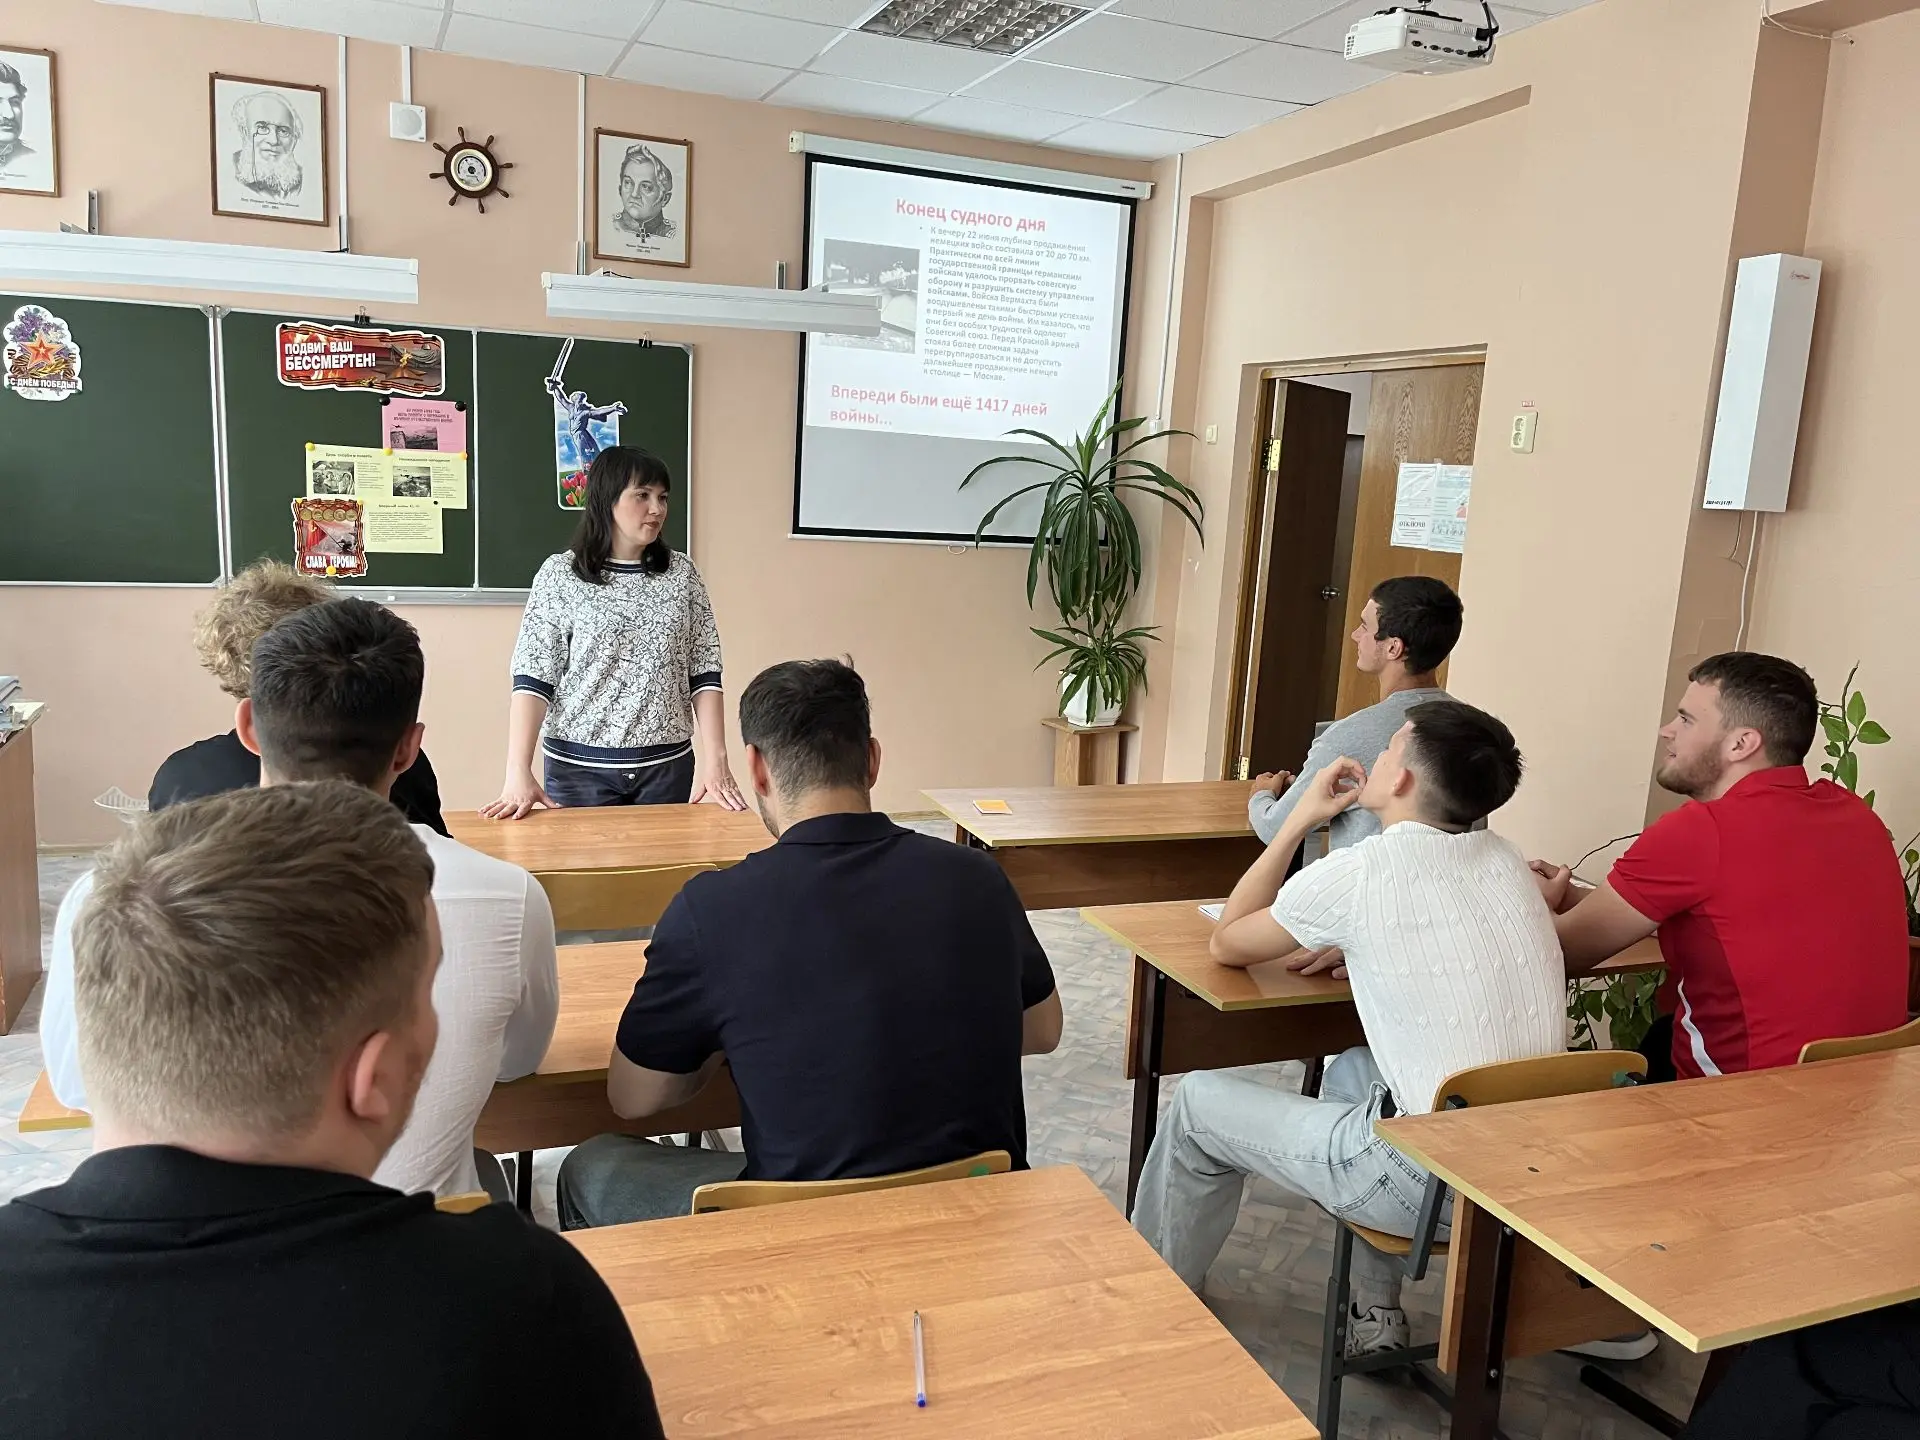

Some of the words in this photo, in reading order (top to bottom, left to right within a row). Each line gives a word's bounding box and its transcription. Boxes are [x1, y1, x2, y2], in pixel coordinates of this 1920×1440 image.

[896, 198, 947, 222] Конец
[950, 209, 1012, 227] судного
[1016, 219, 1046, 233] дня
[931, 226, 936, 234] К
[938, 228, 966, 239] вечеру
[967, 230, 977, 239] 22
[978, 233, 1000, 242] июня
[1001, 236, 1032, 245] глубина
[1033, 240, 1086, 252] продвижения
[930, 239, 970, 249] немецких
[971, 242, 994, 251] войск
[995, 245, 1034, 256] составила
[1045, 250, 1055, 258] 20
[1056, 253, 1067, 261] до
[1068, 252, 1078, 261] 70
[930, 246, 981, 259] Практически
[983, 253, 993, 261] по
[994, 255, 1013, 264] всей
[1014, 258, 1040, 266] линии
[928, 267, 963, 277] войскам
[965, 271, 998, 281] удалось
[998, 275, 1036, 285] прорвать
[1036, 280, 1077, 291] советскую
[929, 257, 997, 271] государственной
[998, 265, 1033, 276] границы
[1034, 270, 1082, 281] германским
[927, 276, 963, 288] оборону
[971, 283, 1014, 293] разрушить
[1015, 287, 1047, 298] систему
[1048, 291, 1095, 302] управления
[927, 287, 970, 298] войсками.
[971, 290, 999, 301] Войска
[1000, 294, 1037, 304] Вермахта
[1038, 298, 1059, 308] были
[927, 299, 987, 310] воодушевлены
[987, 304, 1016, 313] такими
[1018, 306, 1058, 318] быстрыми
[1059, 312, 1095, 321] успехами
[932, 308, 963, 317] первый
[977, 313, 997, 321] день
[1027, 317, 1040, 325] Им
[1040, 320, 1076, 331] казалось,
[925, 318, 941, 326] они
[942, 318, 957, 327] без
[958, 320, 987, 330] особых
[987, 324, 1032, 334] трудностей
[1033, 328, 1068, 338] одолеют
[925, 326, 966, 338] Советский
[991, 333, 1016, 345] Перед
[1017, 335, 1049, 346] Красной
[1050, 341, 1080, 350] армией
[284, 343, 326, 356] ПОДВИГ
[329, 341, 353, 353] ВАШ
[924, 338, 951, 347] стояла
[952, 339, 977, 349] более
[978, 343, 1011, 352] сложная
[1013, 347, 1039, 356] задача
[285, 353, 376, 371] БЕССМЕРТЕН!
[923, 358, 973, 369] дальнейшее
[974, 363, 1028, 374] продвижение
[1029, 368, 1058, 377] немцев
[924, 348, 1004, 361] перегруппироваться
[1012, 356, 1022, 364] не
[1023, 357, 1062, 367] допустить
[10, 377, 16, 386] С
[929, 369, 960, 378] столице
[973, 371, 1006, 381] Москве.
[831, 384, 895, 403] Впереди
[900, 390, 938, 407] были
[942, 396, 972, 412] ещё
[976, 397, 1008, 412] 1417
[1012, 402, 1048, 416] дней
[830, 408, 892, 425] войны...
[305, 555, 327, 569] СЛАВА
